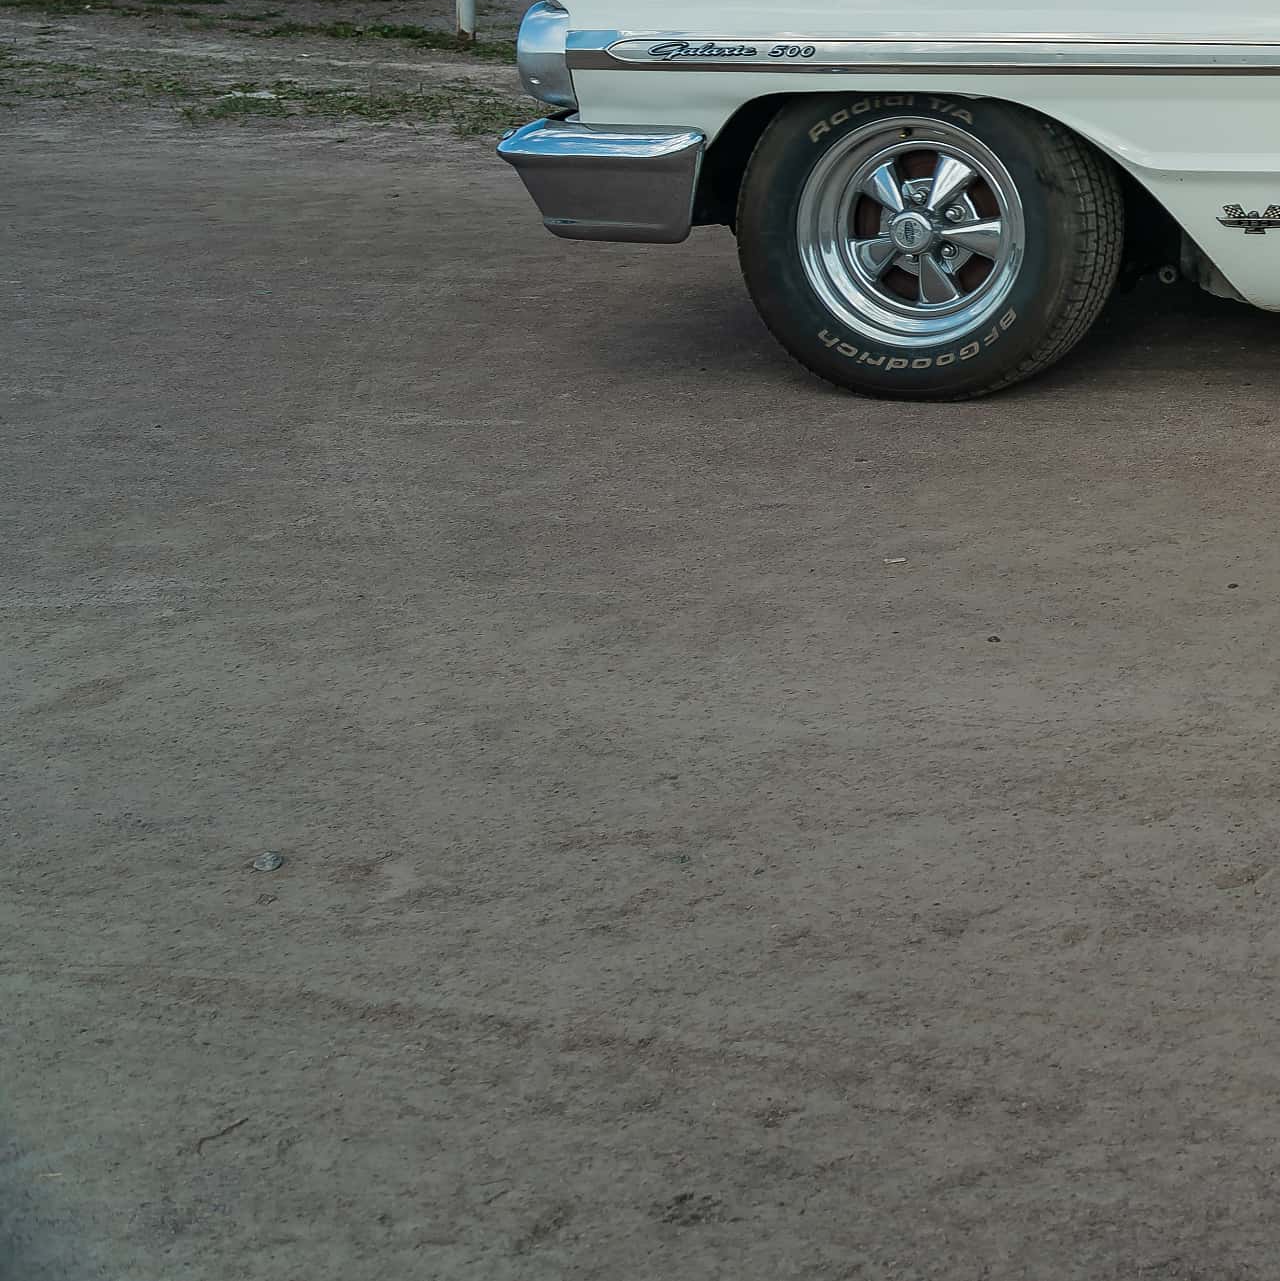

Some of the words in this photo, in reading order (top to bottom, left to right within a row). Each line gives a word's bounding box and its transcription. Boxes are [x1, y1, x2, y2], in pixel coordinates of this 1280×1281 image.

[647, 41, 758, 61] Galaxie
[768, 44, 816, 58] 500
[808, 95, 915, 143] Radial
[928, 97, 974, 125] T/A
